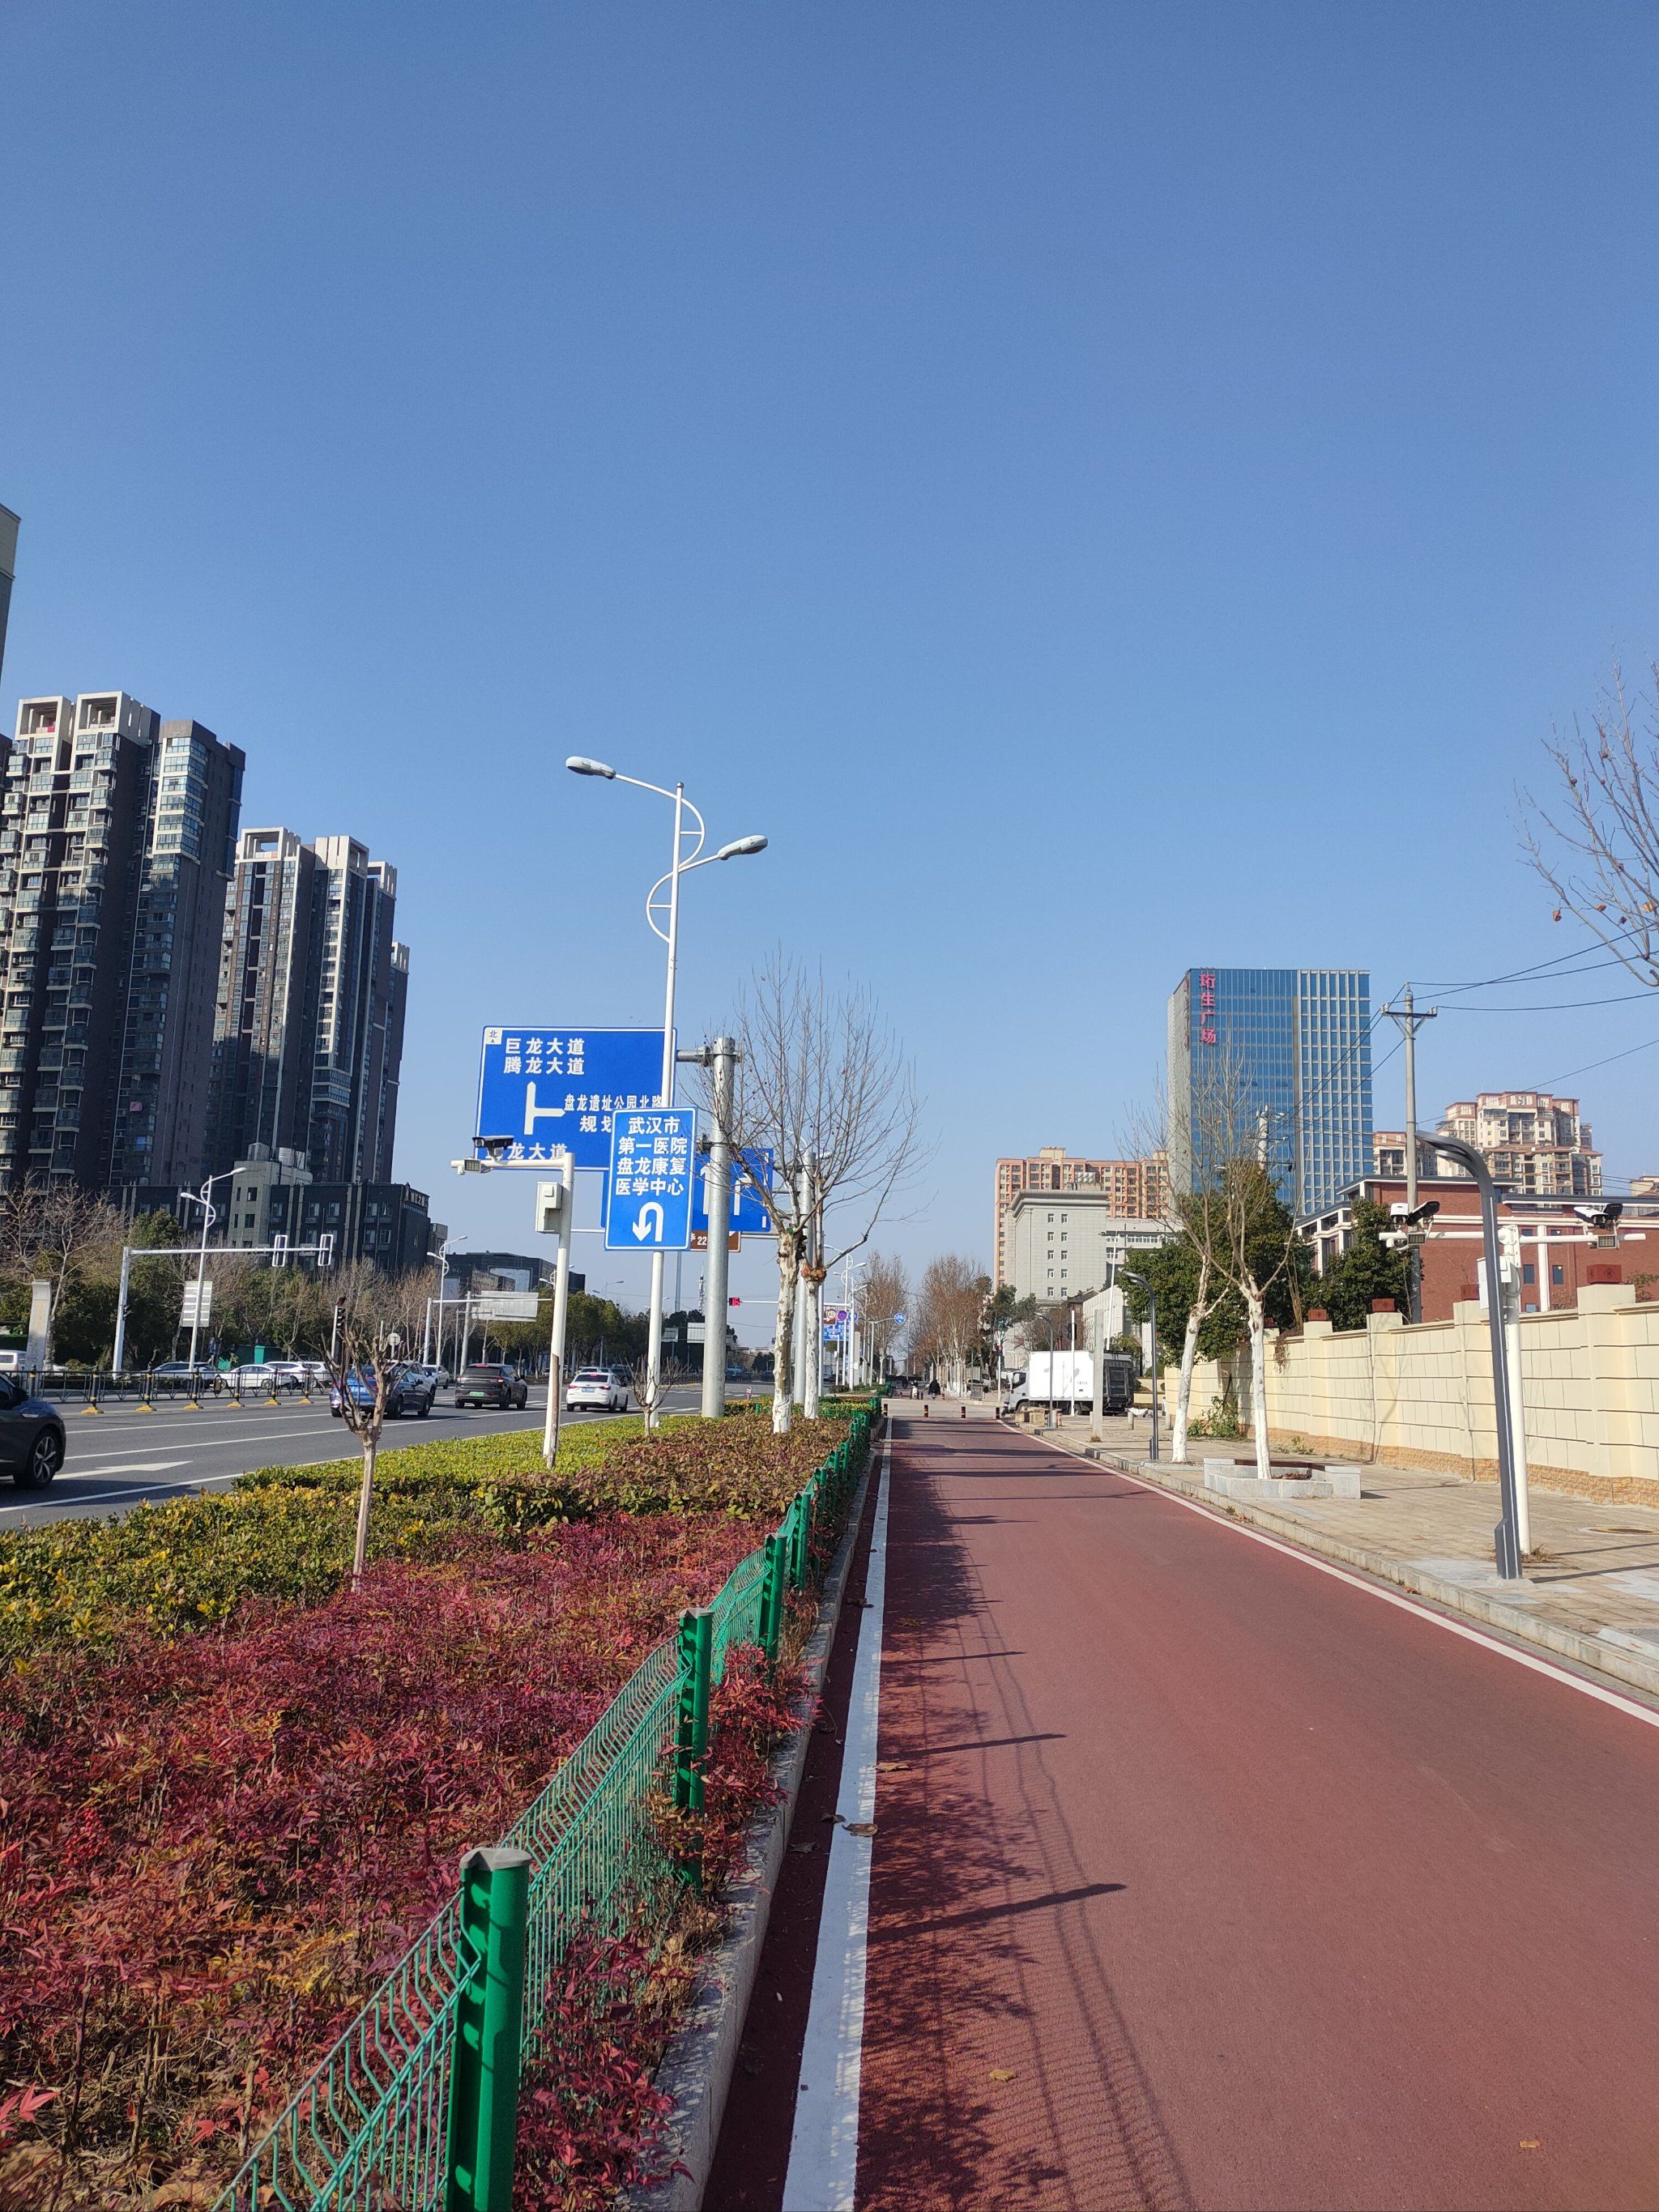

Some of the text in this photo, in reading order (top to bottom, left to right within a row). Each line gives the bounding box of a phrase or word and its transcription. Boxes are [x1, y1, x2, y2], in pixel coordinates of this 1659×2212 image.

[489, 1029, 497, 1038] 北
[505, 1038, 584, 1055] 巨龙大道
[503, 1056, 584, 1075] 腾龙大道
[564, 1093, 662, 1111] 盘龙遗址公园北路
[628, 1116, 680, 1135] 武汉市
[618, 1136, 688, 1155] 第一医院
[616, 1157, 686, 1175] 盘龙康复
[616, 1177, 684, 1196] 医学中心
